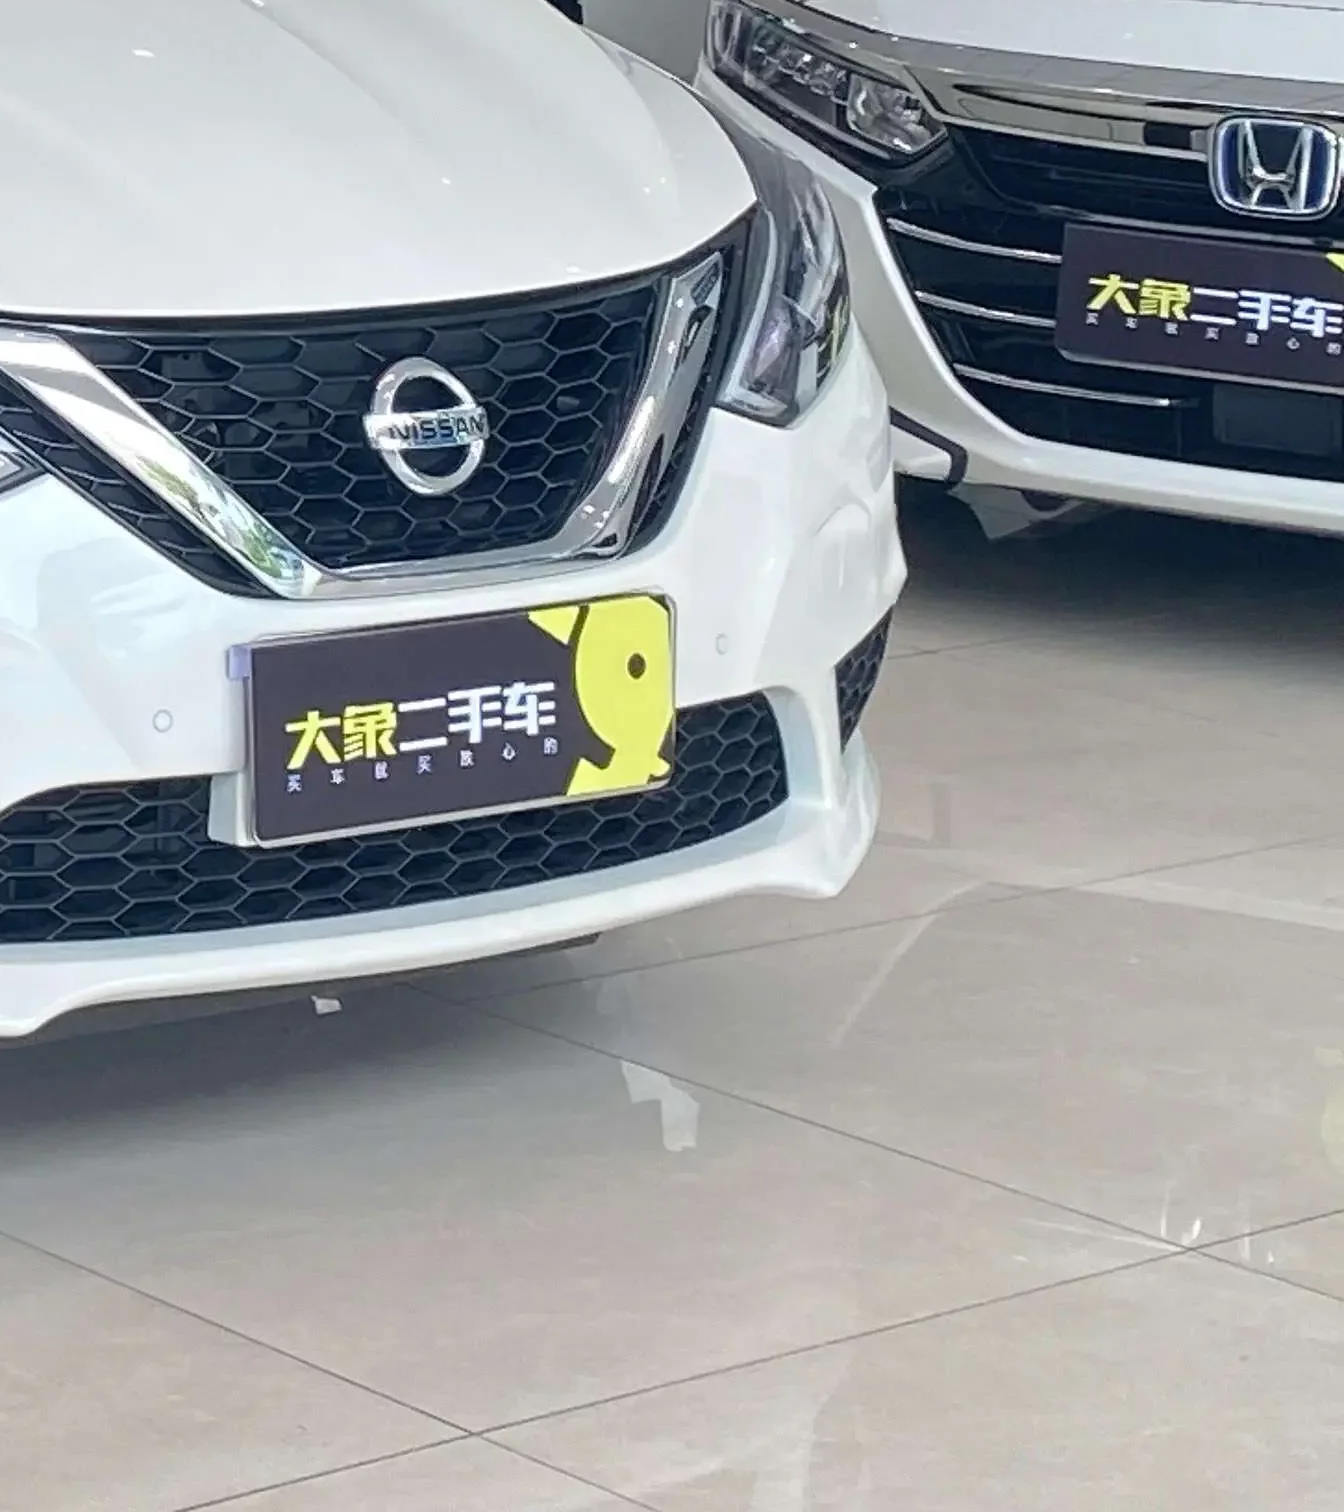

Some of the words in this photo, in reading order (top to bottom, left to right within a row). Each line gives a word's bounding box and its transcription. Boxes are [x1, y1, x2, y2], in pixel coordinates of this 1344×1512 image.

[1086, 273, 1344, 339] 大象二手车
[387, 414, 487, 440] NISSAN
[284, 681, 557, 770] 大象二手车
